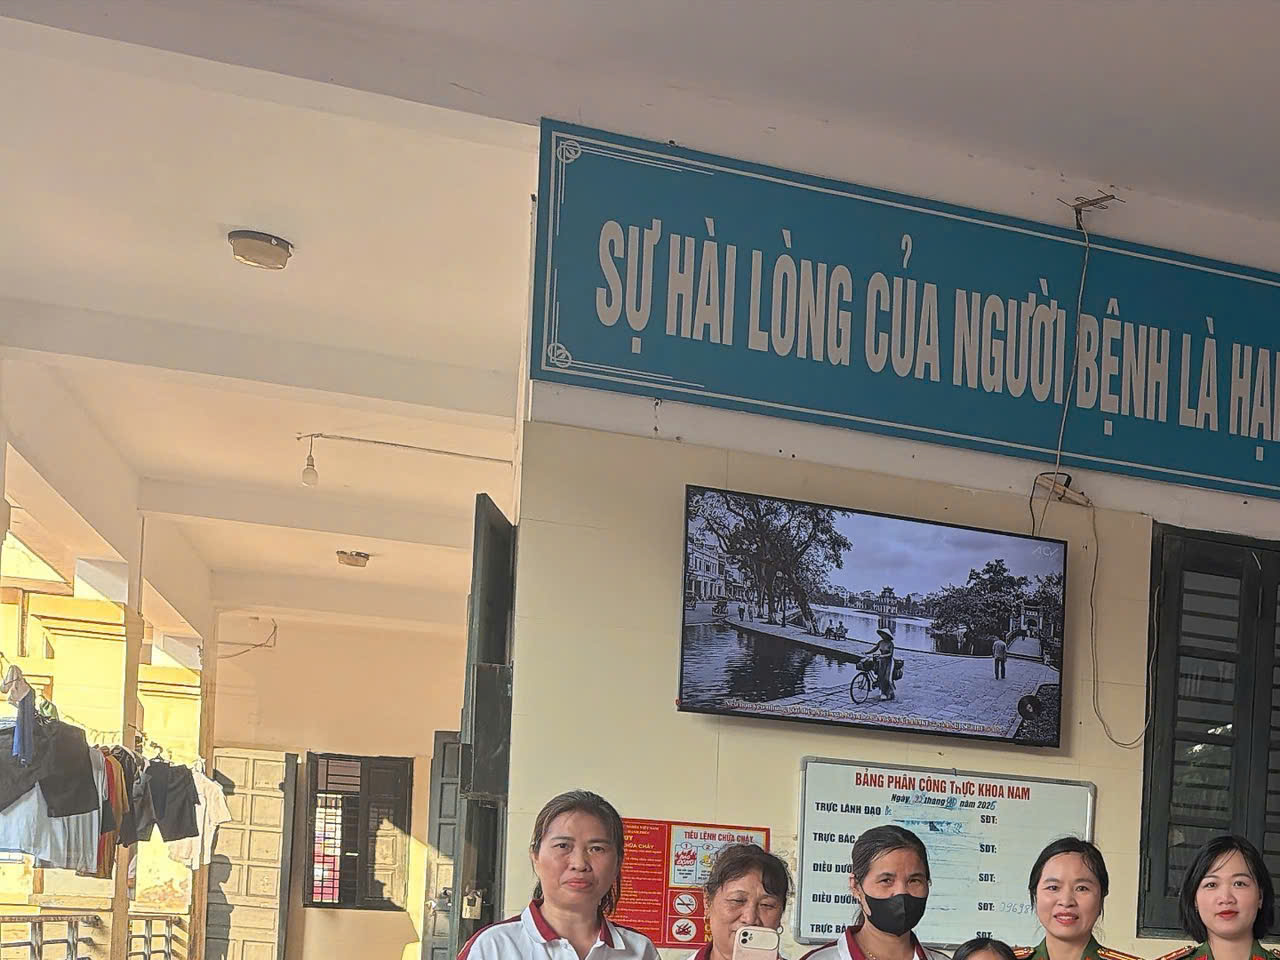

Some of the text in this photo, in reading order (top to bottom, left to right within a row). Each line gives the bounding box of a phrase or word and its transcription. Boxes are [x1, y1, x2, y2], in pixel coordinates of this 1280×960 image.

[596, 219, 661, 354] SỰ
[666, 217, 736, 345] HÀI
[748, 229, 852, 366] LÒNG
[866, 234, 940, 382] CỦA
[953, 279, 1066, 404] NGƯỜI
[1077, 299, 1169, 435] BỆNH
[1179, 316, 1218, 432] LÀ
[855, 768, 884, 788] BẢNG
[887, 773, 916, 791] PHÂN
[919, 776, 946, 793] CÔNG
[978, 784, 1004, 798] KHOA
[1007, 787, 1030, 800] NAM
[891, 794, 912, 804] Ngày
[815, 802, 838, 813] TRỰC
[864, 806, 881, 816] ĐẠO
[980, 815, 997, 824] SĐT:
[813, 832, 855, 844] TRỰC BÁC
[980, 844, 997, 853] SĐT:
[979, 873, 995, 882] SĐT:
[978, 902, 994, 911] SĐT:
[810, 924, 832, 934] TRỰC
